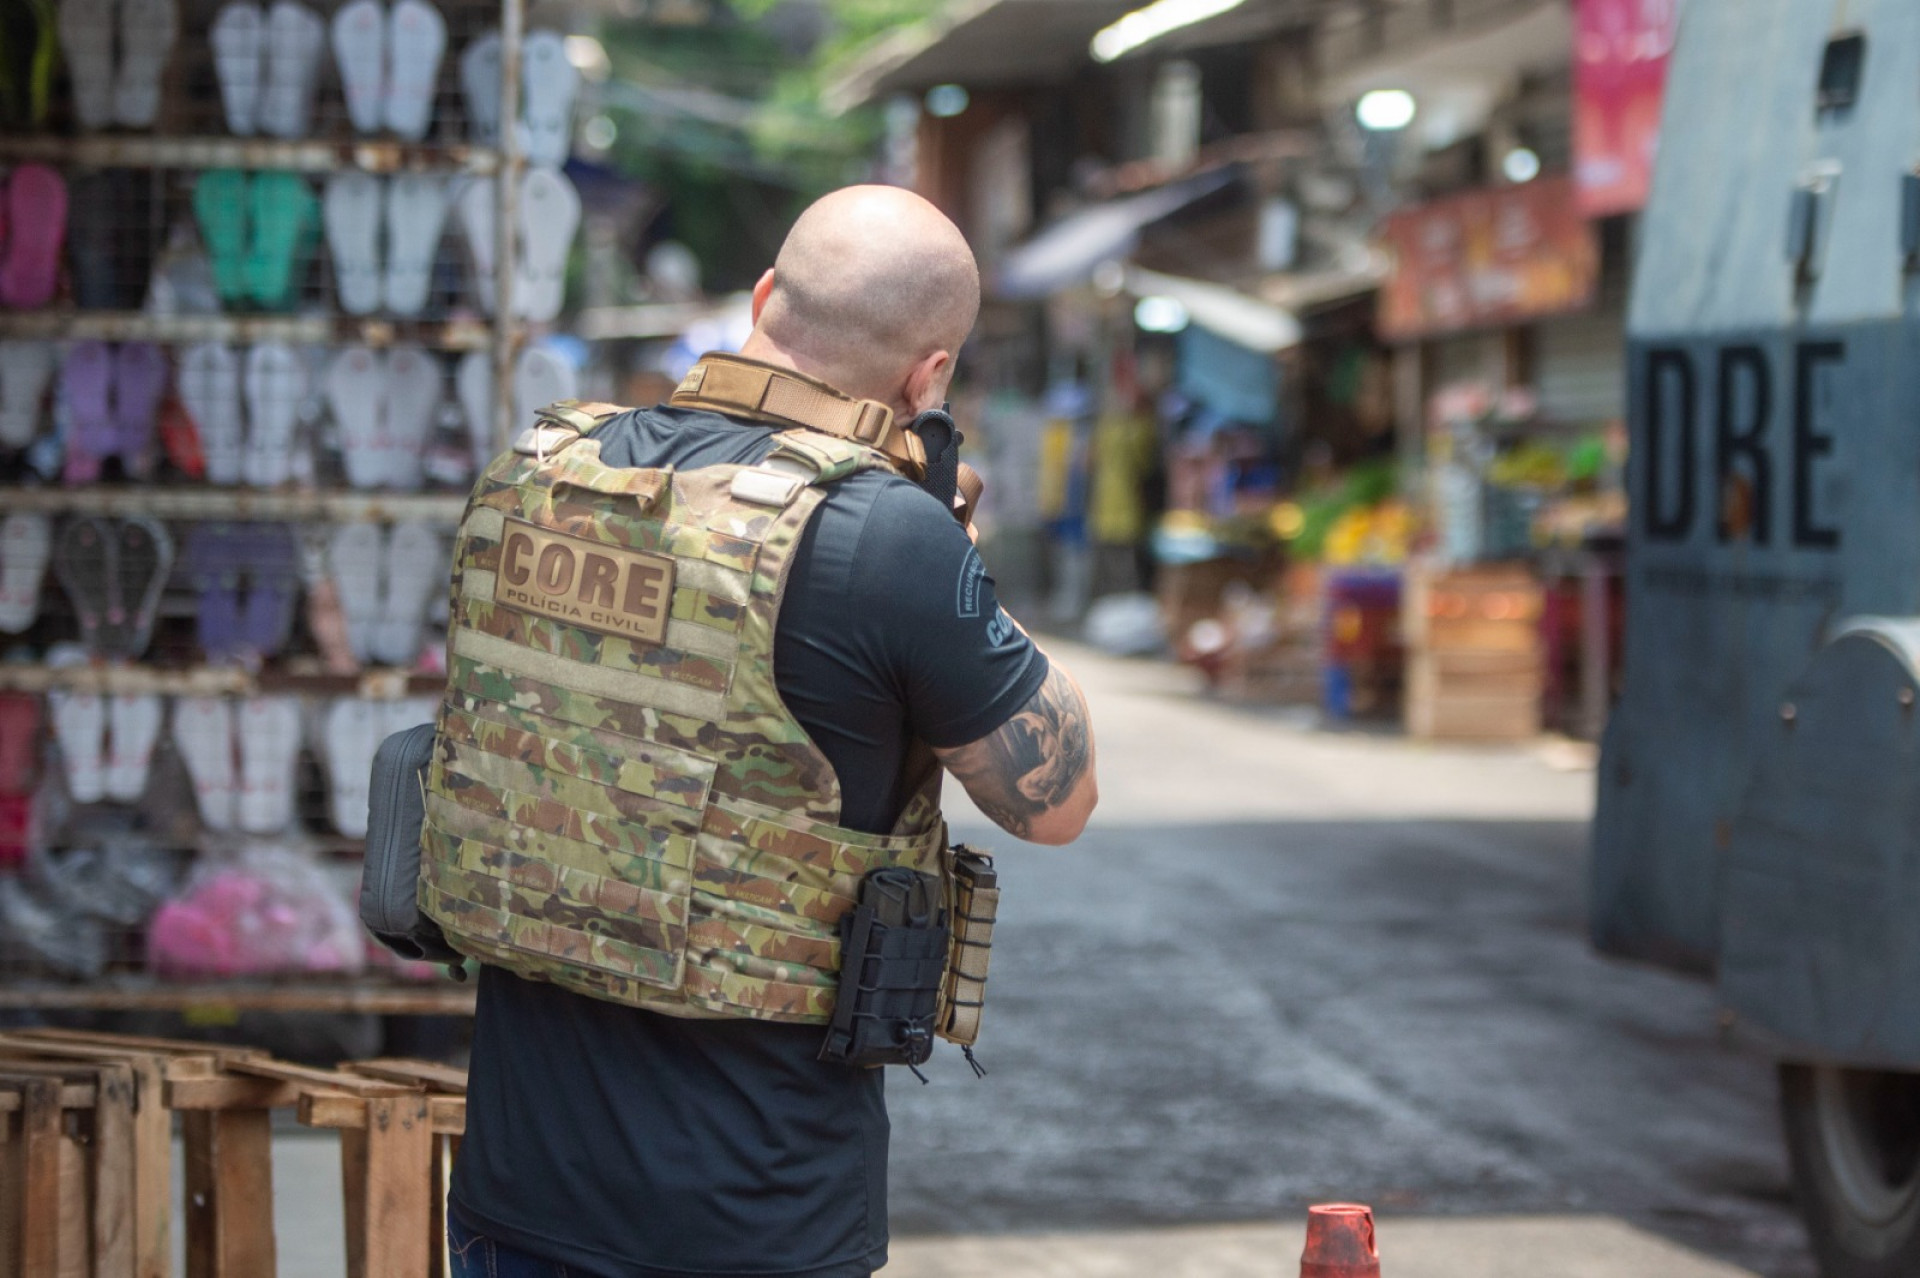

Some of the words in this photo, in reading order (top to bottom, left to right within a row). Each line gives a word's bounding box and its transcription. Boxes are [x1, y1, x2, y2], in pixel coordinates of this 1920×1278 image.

[1644, 341, 1846, 548] DRE
[504, 532, 663, 619] CORE
[507, 588, 582, 618] POLÍCIA
[590, 611, 645, 633] CIVIL
